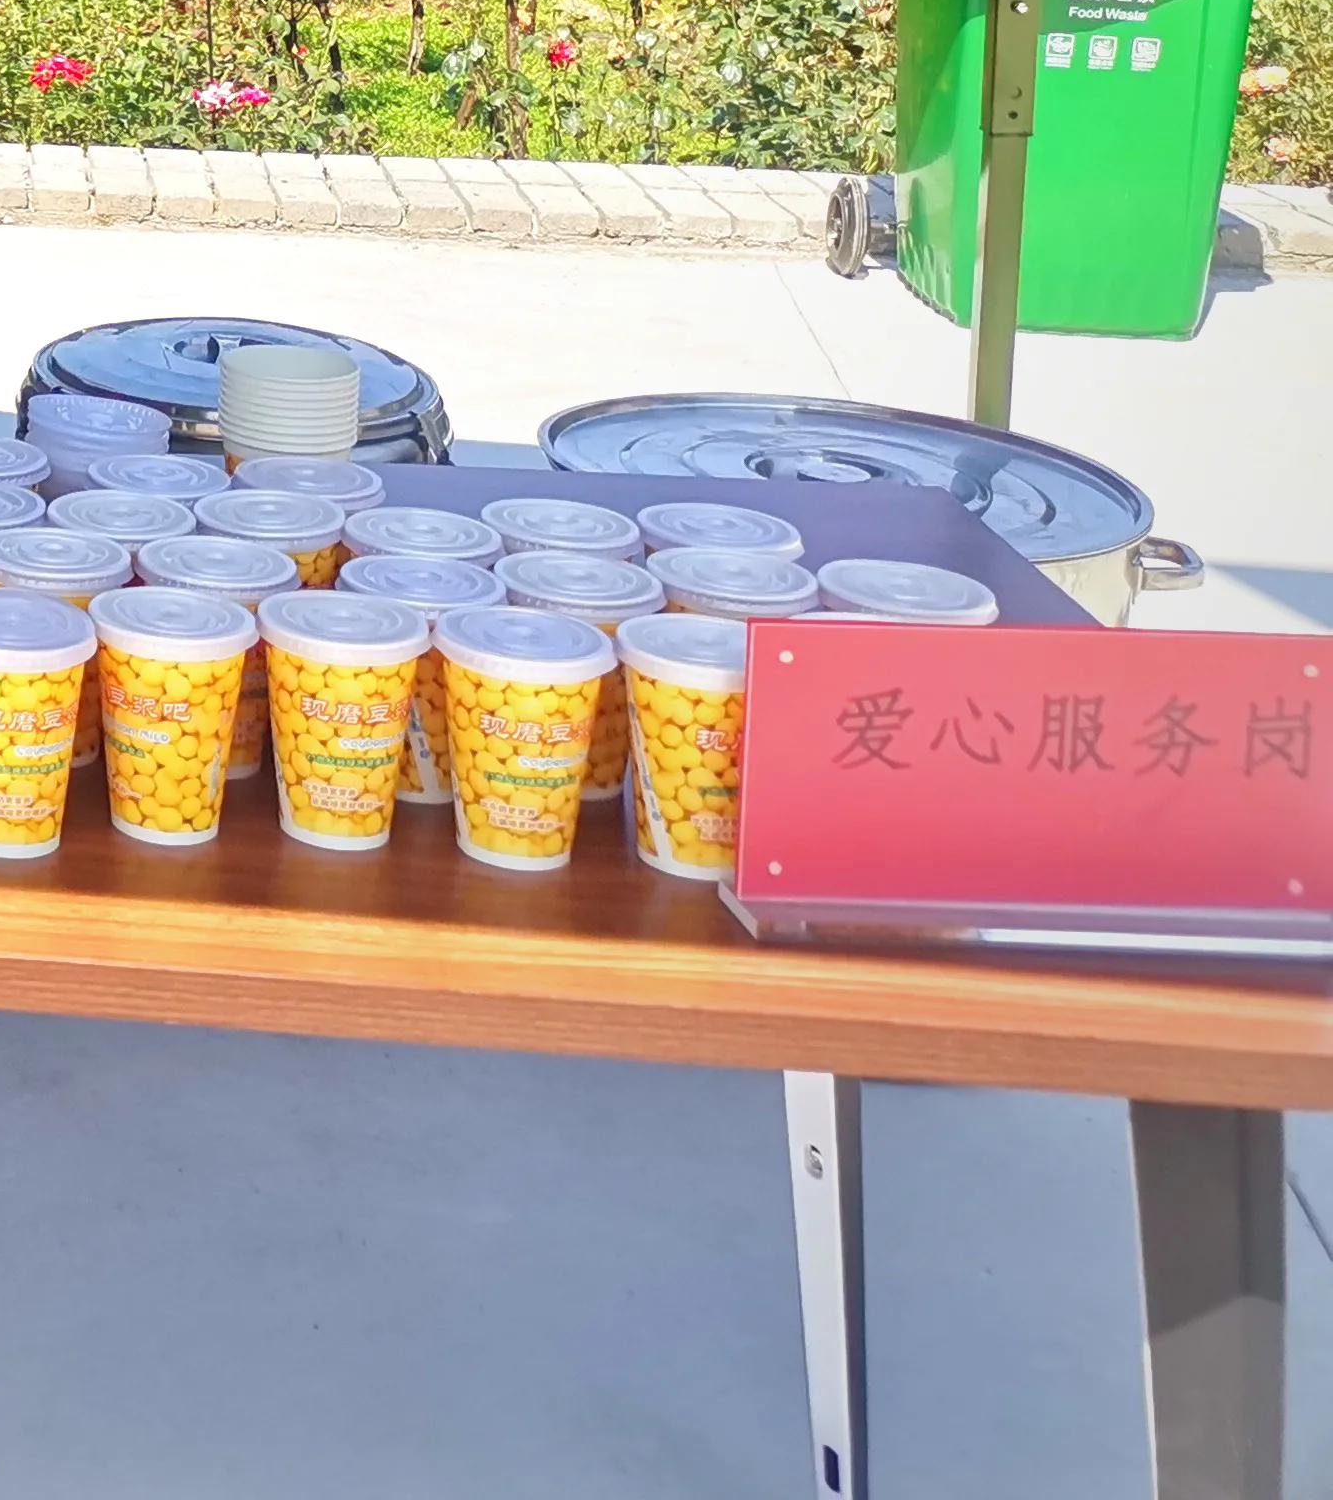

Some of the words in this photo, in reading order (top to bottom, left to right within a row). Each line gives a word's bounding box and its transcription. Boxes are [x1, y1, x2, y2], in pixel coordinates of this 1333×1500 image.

[1068, 6, 1103, 19] Food
[1105, 8, 1148, 21] Waste
[831, 687, 1314, 779] 爱心服务岗
